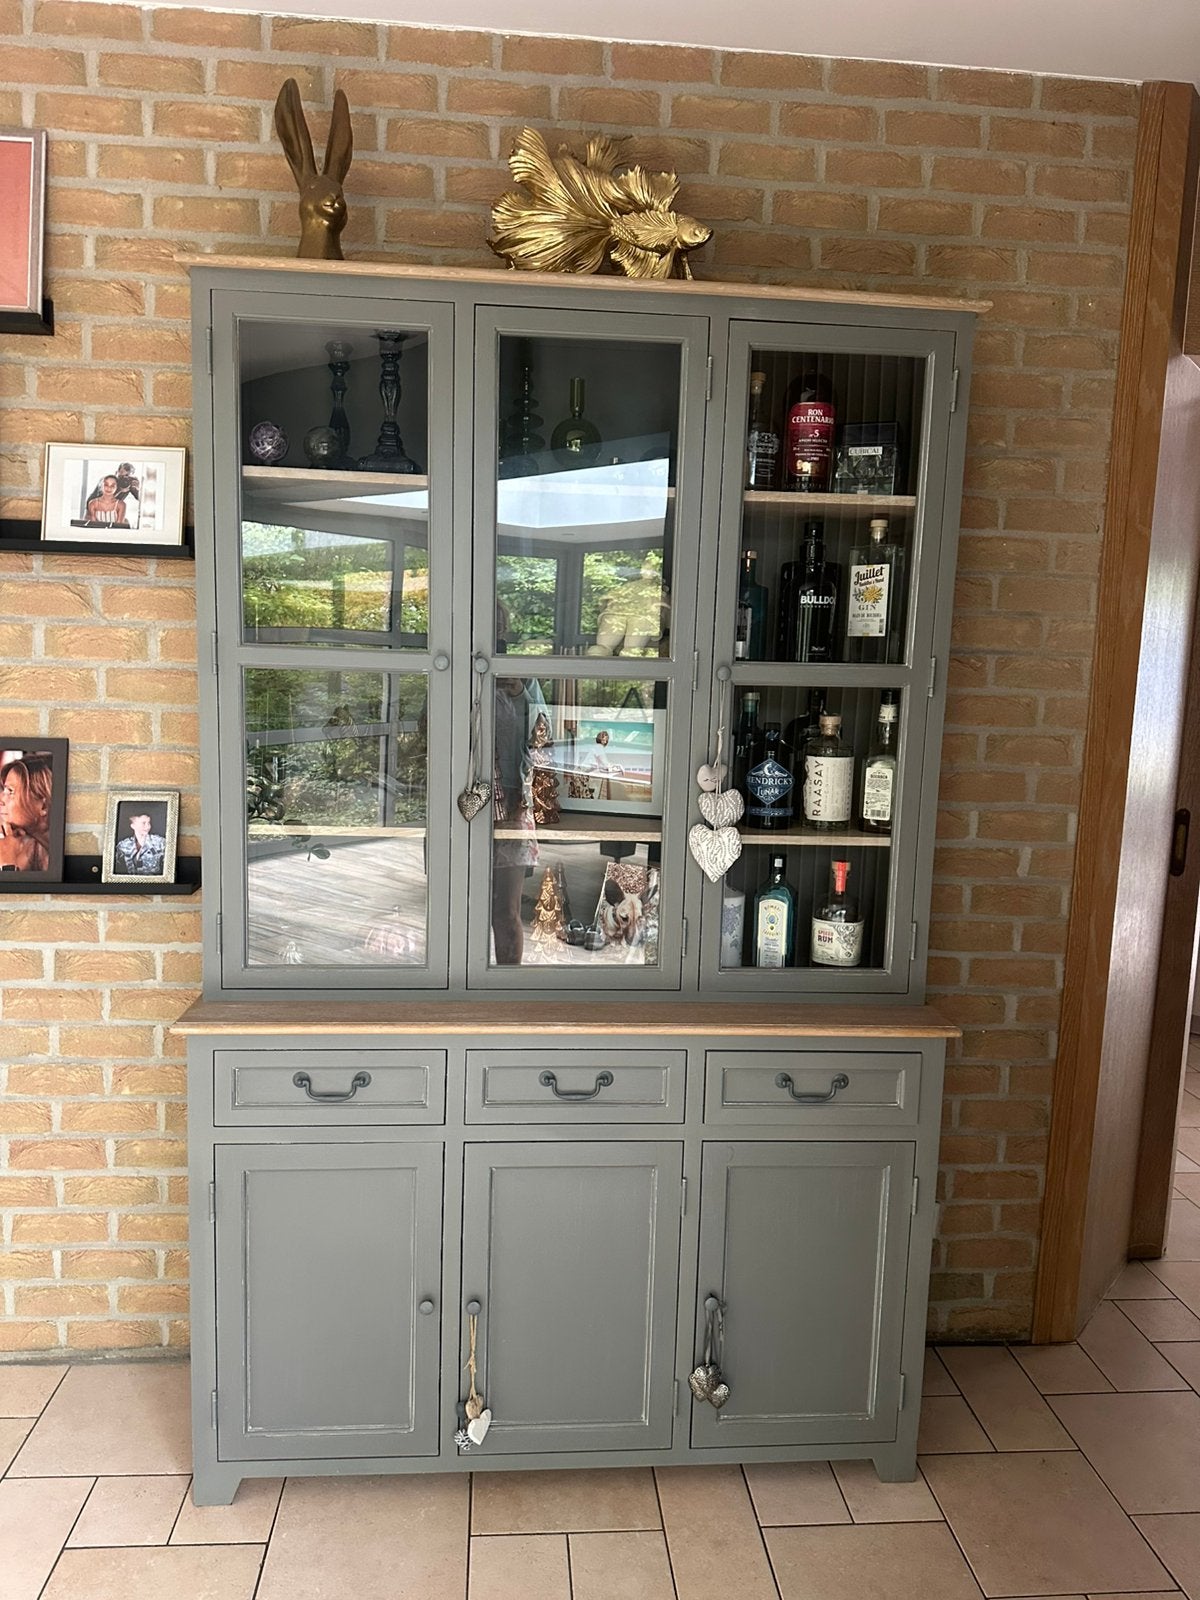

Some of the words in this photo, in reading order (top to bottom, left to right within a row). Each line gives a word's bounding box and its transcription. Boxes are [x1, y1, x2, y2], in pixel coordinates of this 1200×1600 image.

[791, 416, 834, 424] CENTENARIO
[854, 566, 885, 585] Juillet
[812, 760, 824, 817] RAASAY
[817, 935, 833, 943] RUM
